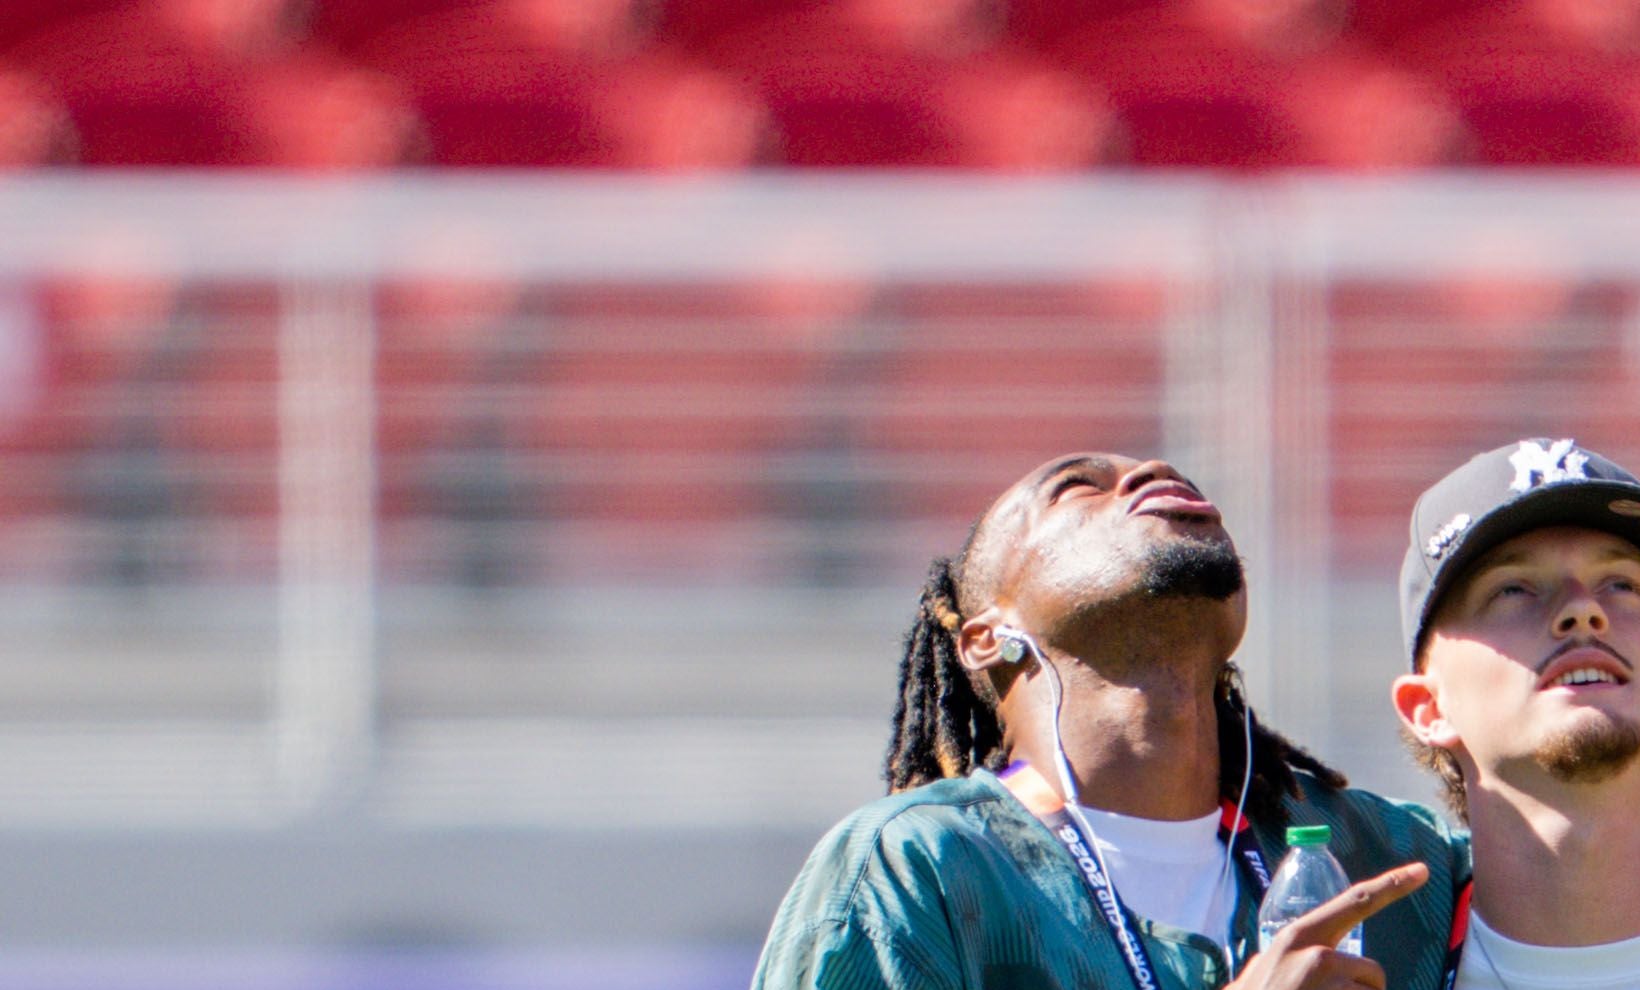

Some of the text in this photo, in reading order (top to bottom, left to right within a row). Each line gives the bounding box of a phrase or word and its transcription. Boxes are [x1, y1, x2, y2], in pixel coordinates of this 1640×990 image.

[1508, 438, 1589, 493] NY
[1059, 826, 1107, 888] 2026
[1243, 850, 1272, 888] FIFA
